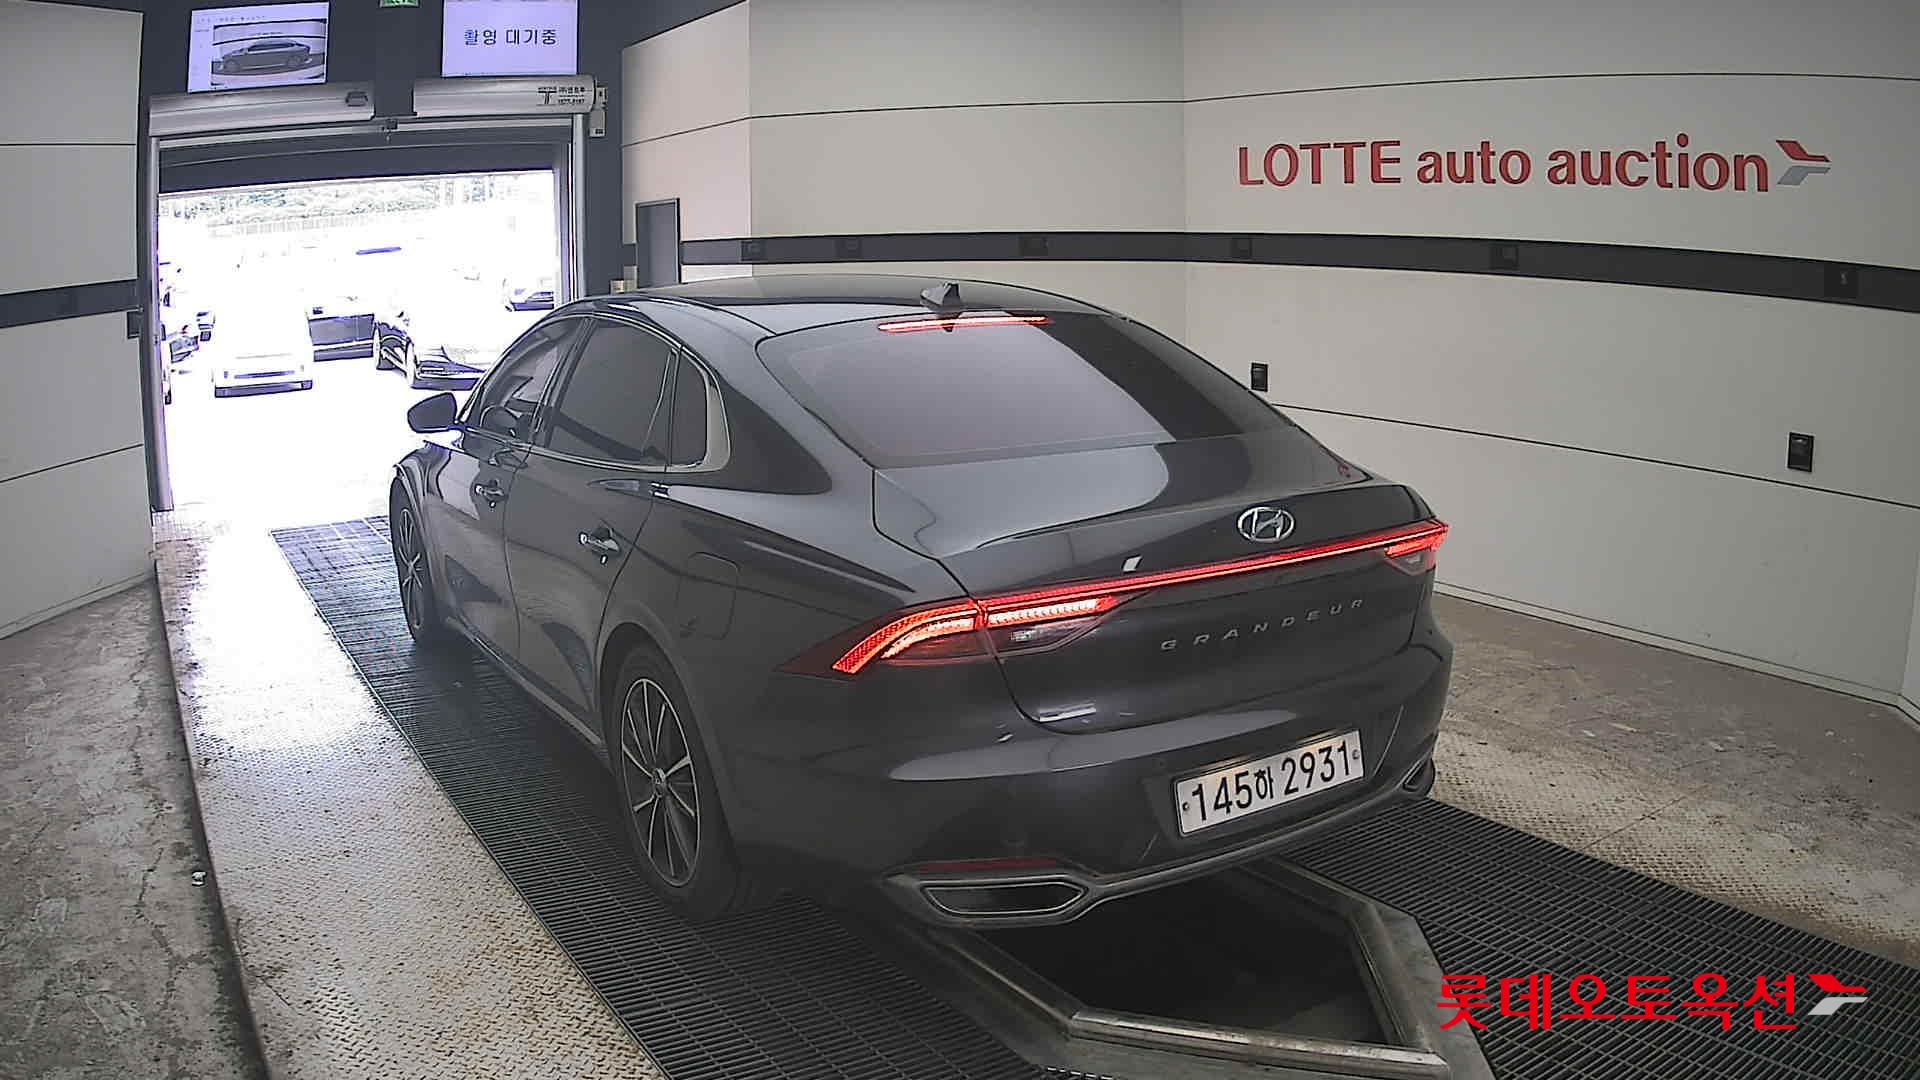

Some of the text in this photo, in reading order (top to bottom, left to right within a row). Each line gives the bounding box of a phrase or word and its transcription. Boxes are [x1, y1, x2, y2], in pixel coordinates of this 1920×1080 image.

[464, 29, 557, 46] 촬영 대기중
[1238, 133, 1769, 192] LOTTE auto auction
[1160, 598, 1363, 651] GRANDEUR
[1191, 740, 1350, 822] 145하 2931
